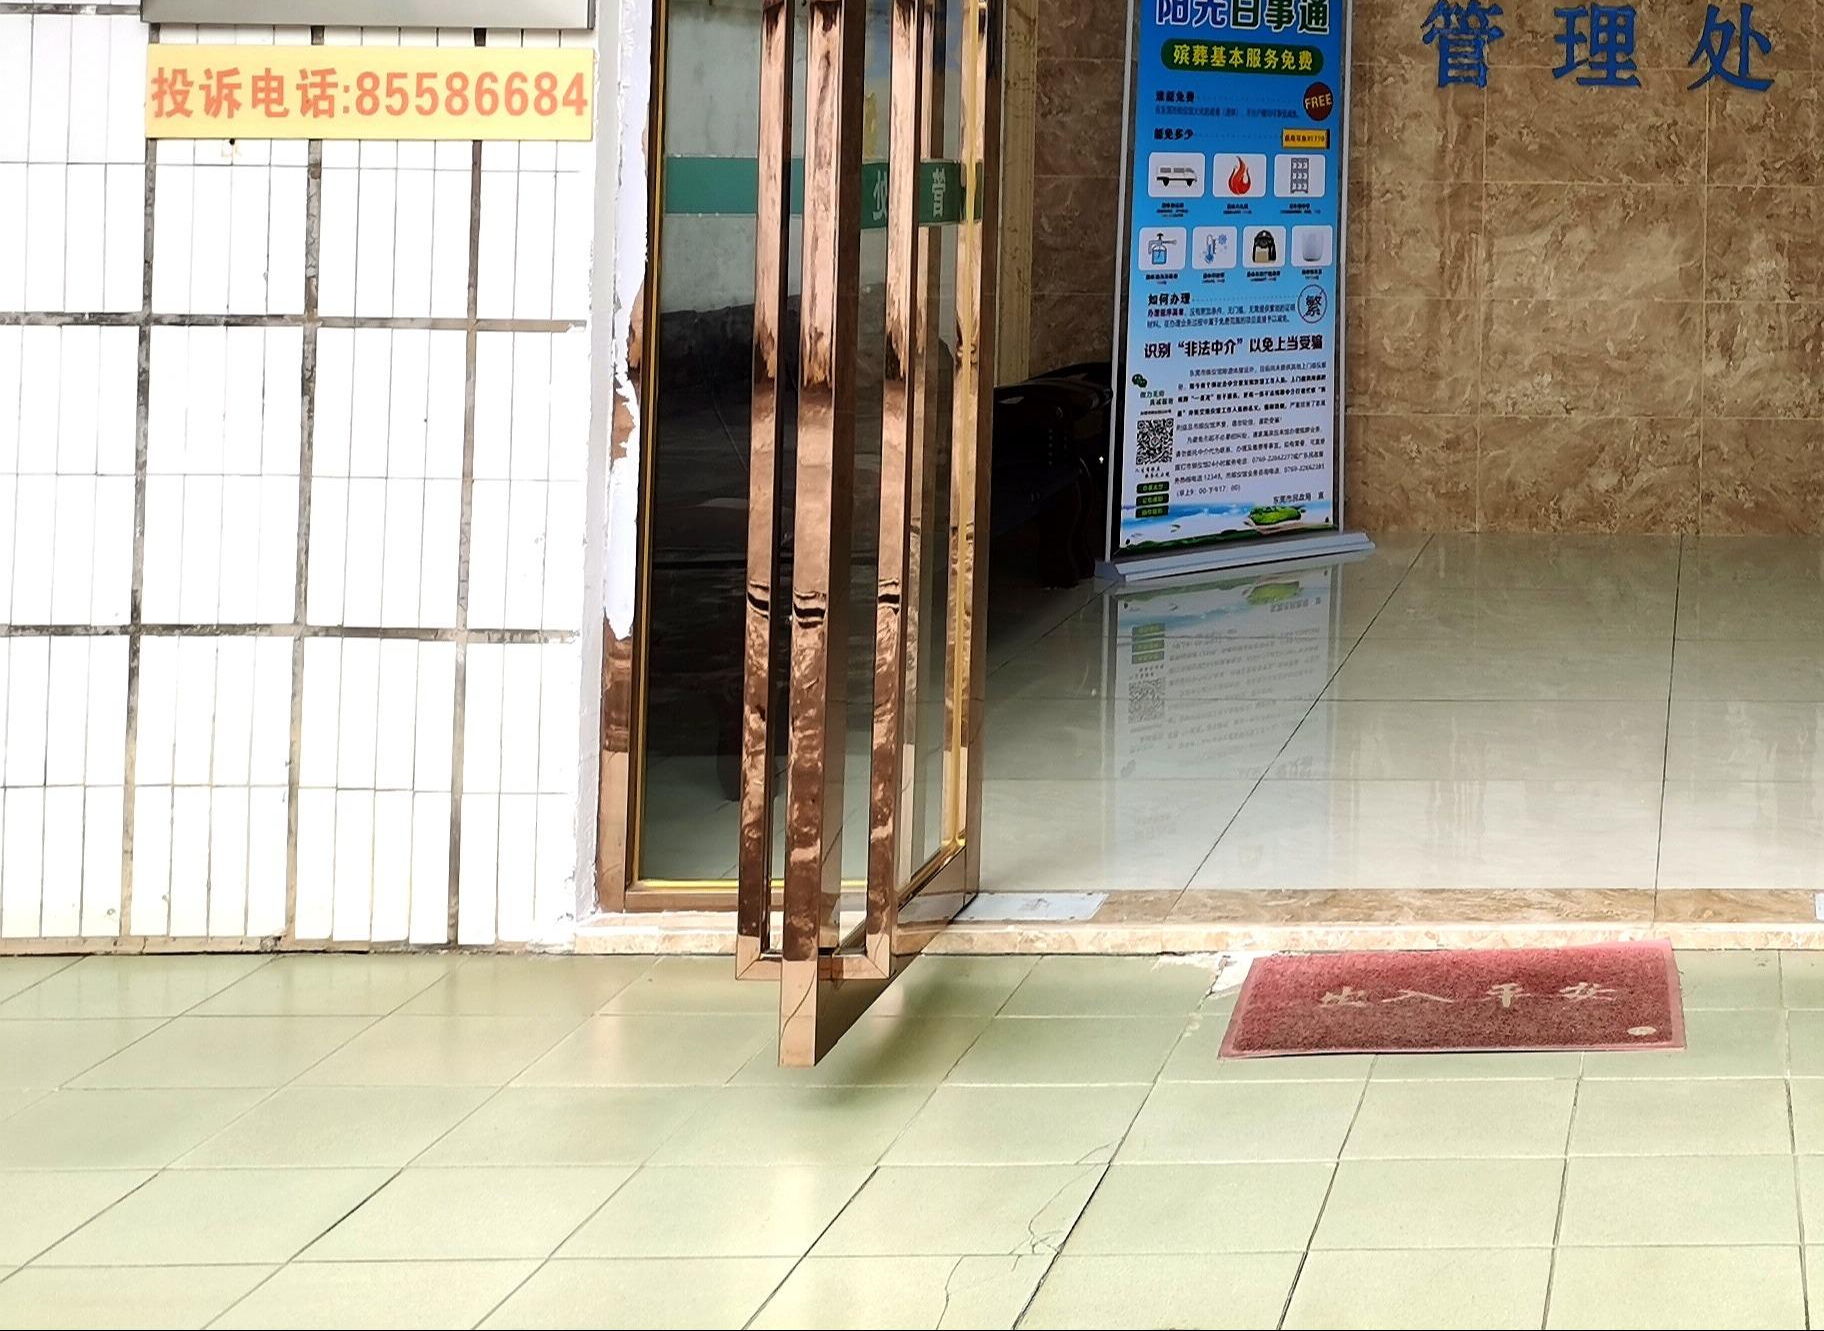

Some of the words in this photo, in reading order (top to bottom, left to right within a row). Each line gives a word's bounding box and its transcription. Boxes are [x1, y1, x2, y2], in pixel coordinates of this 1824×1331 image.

[1173, 44, 1313, 71] 殡葬基本服务免费
[151, 67, 588, 119] 投诉电话:85586684
[1304, 94, 1332, 109] FREE
[1148, 293, 1191, 306] 如何办理
[1305, 295, 1322, 317] 繁
